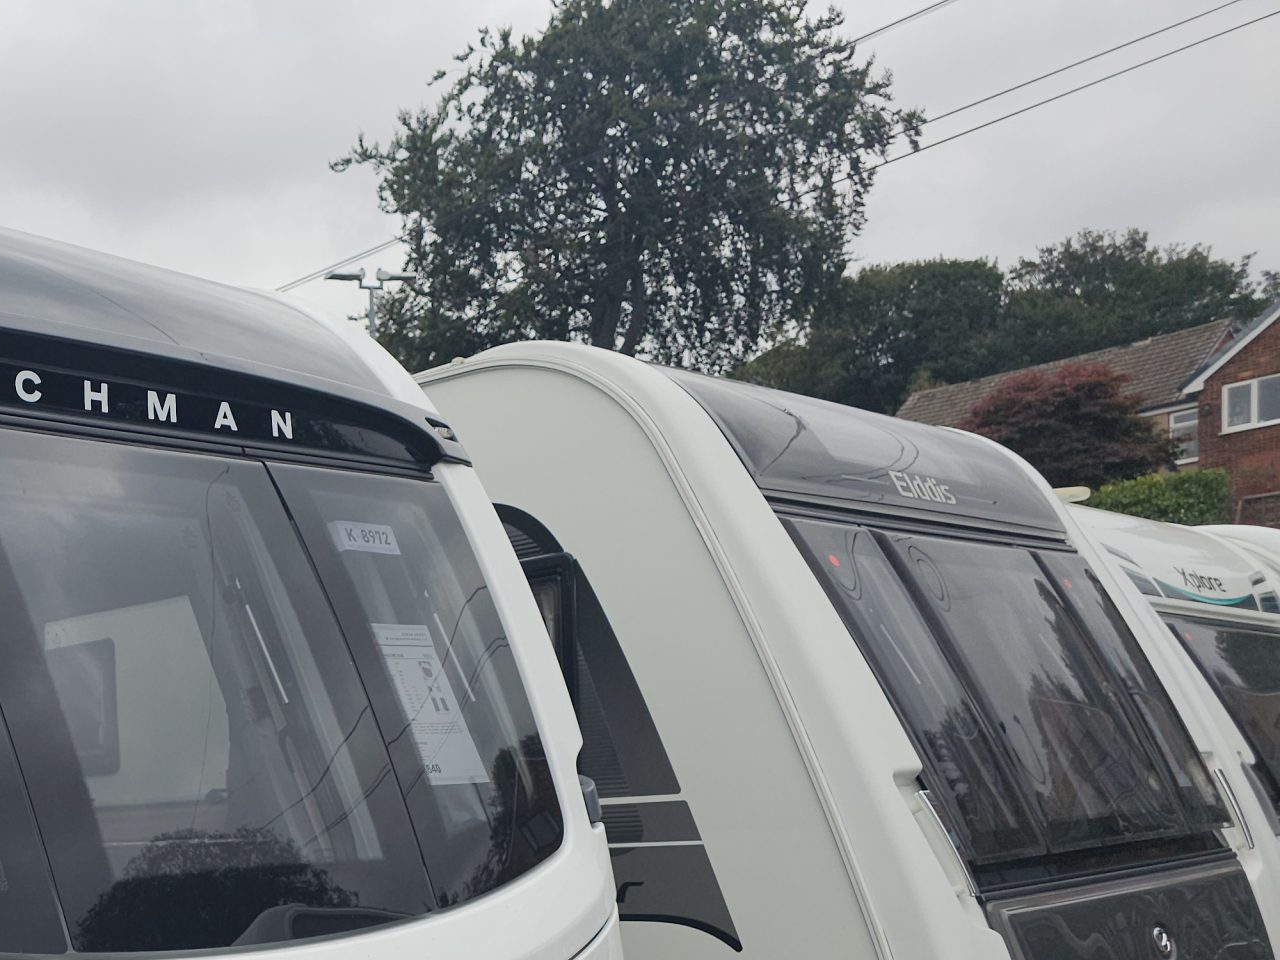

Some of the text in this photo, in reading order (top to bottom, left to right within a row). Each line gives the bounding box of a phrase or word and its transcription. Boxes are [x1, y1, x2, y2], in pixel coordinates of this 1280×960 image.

[888, 470, 956, 504] Elddis
[360, 529, 392, 545] 8972
[1173, 566, 1227, 592] Xplore
